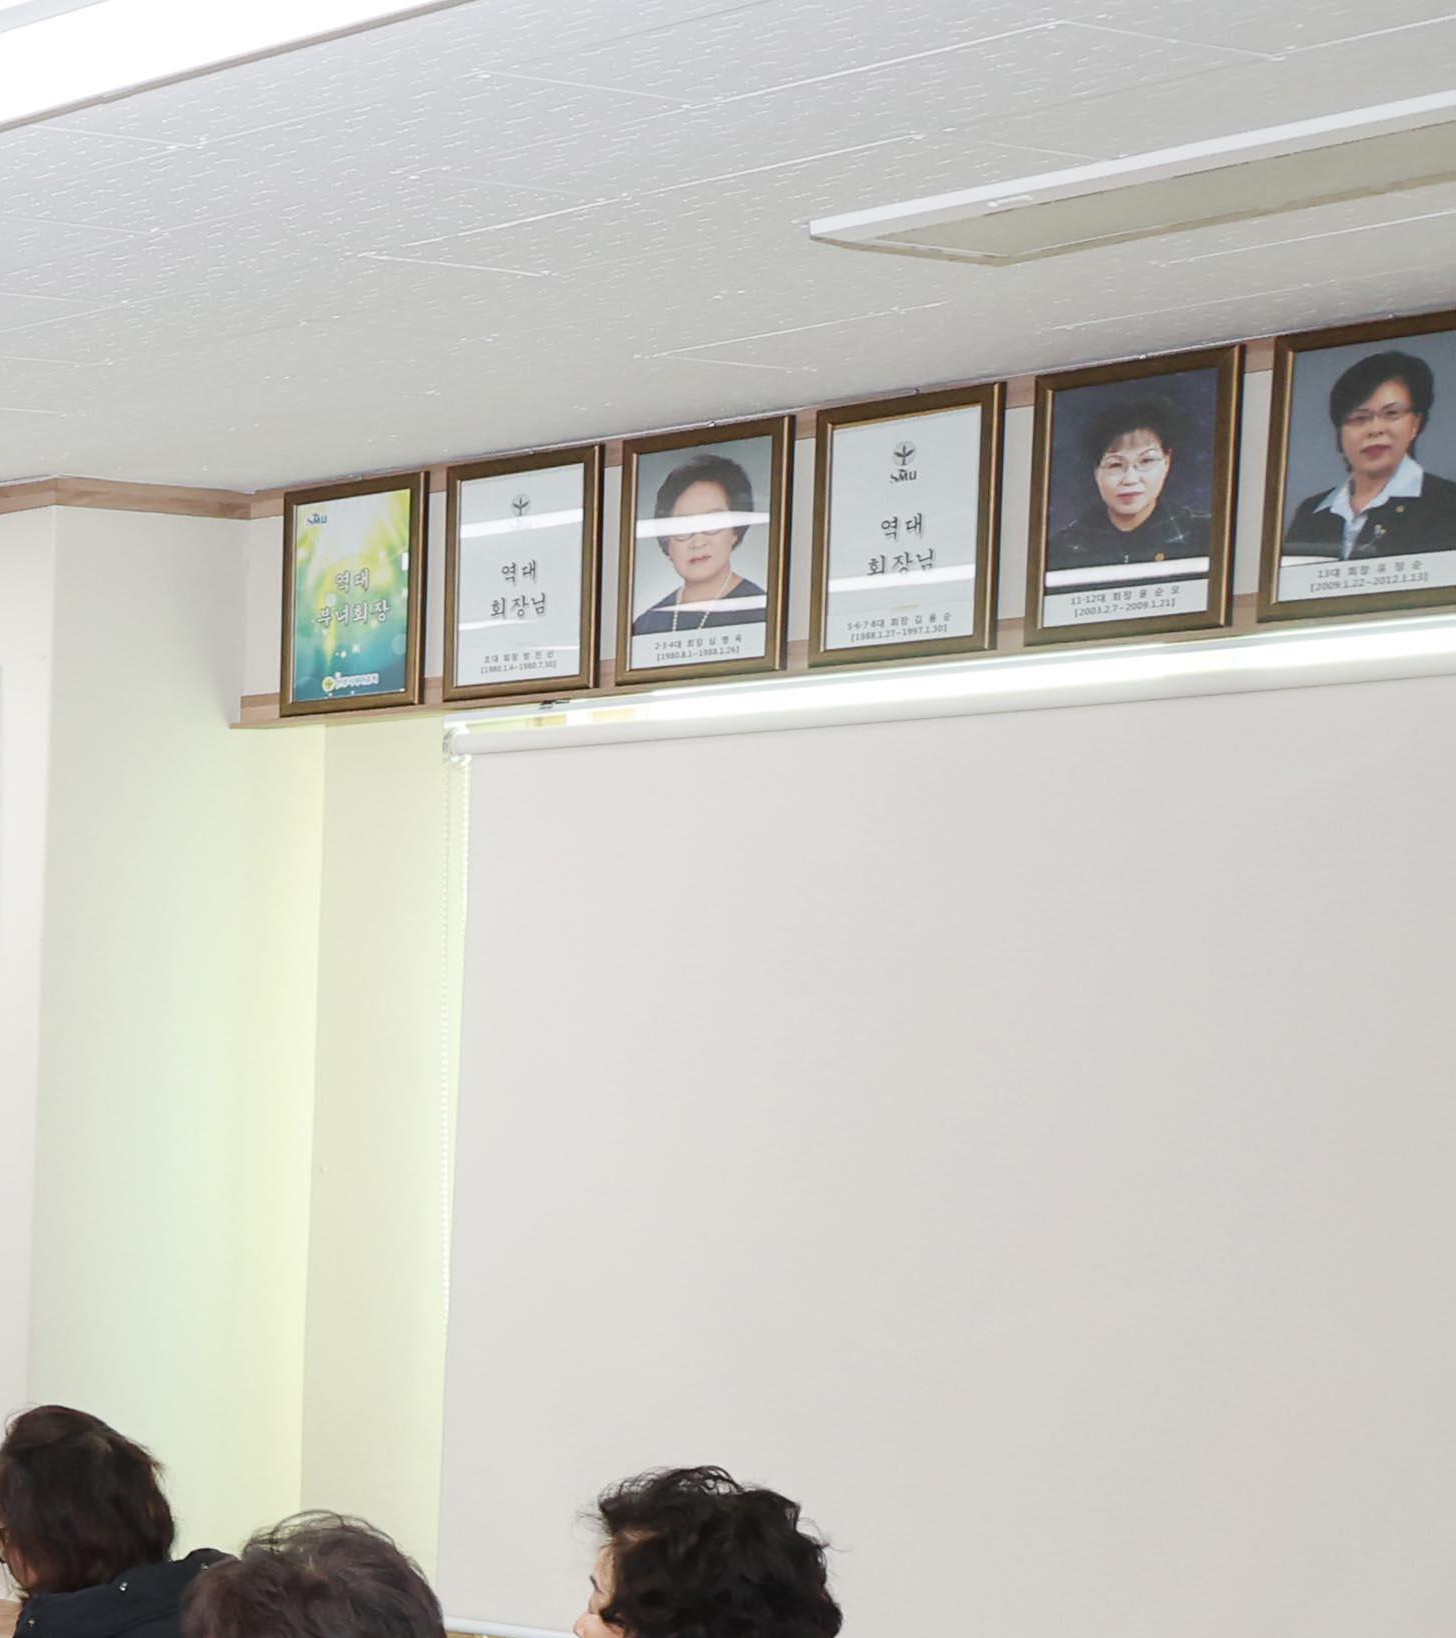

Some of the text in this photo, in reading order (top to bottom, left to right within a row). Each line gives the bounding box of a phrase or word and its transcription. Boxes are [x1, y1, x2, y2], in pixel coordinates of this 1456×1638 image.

[881, 513, 923, 540] 역대
[335, 569, 370, 593] 역대
[501, 559, 538, 585] 역대
[317, 599, 391, 629] 부녀회장
[490, 592, 547, 619] 회장님
